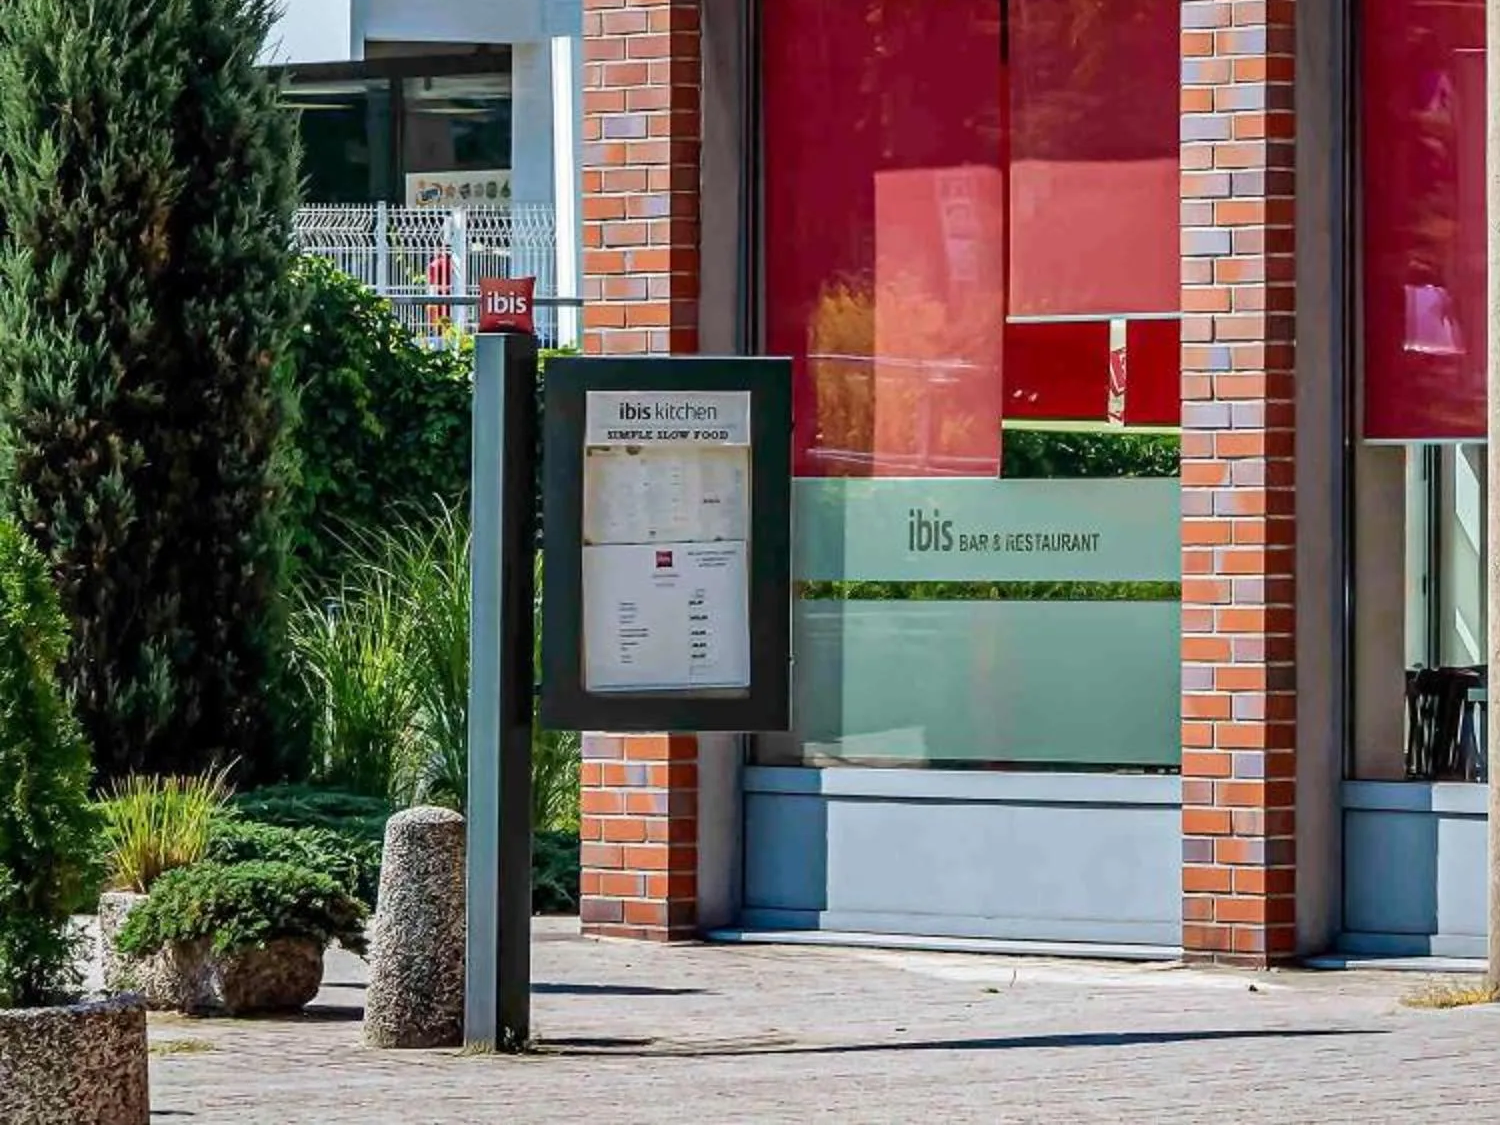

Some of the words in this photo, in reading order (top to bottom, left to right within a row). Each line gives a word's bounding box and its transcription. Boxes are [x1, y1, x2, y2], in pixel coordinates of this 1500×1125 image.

[487, 291, 528, 314] ibis
[619, 402, 651, 420] ibis
[655, 402, 717, 420] kitchen
[657, 430, 690, 440] SLOW
[694, 430, 729, 440] FOOD
[908, 508, 953, 553] ibis
[959, 533, 989, 552] BAR
[1005, 532, 1100, 553] RESTAURANT
